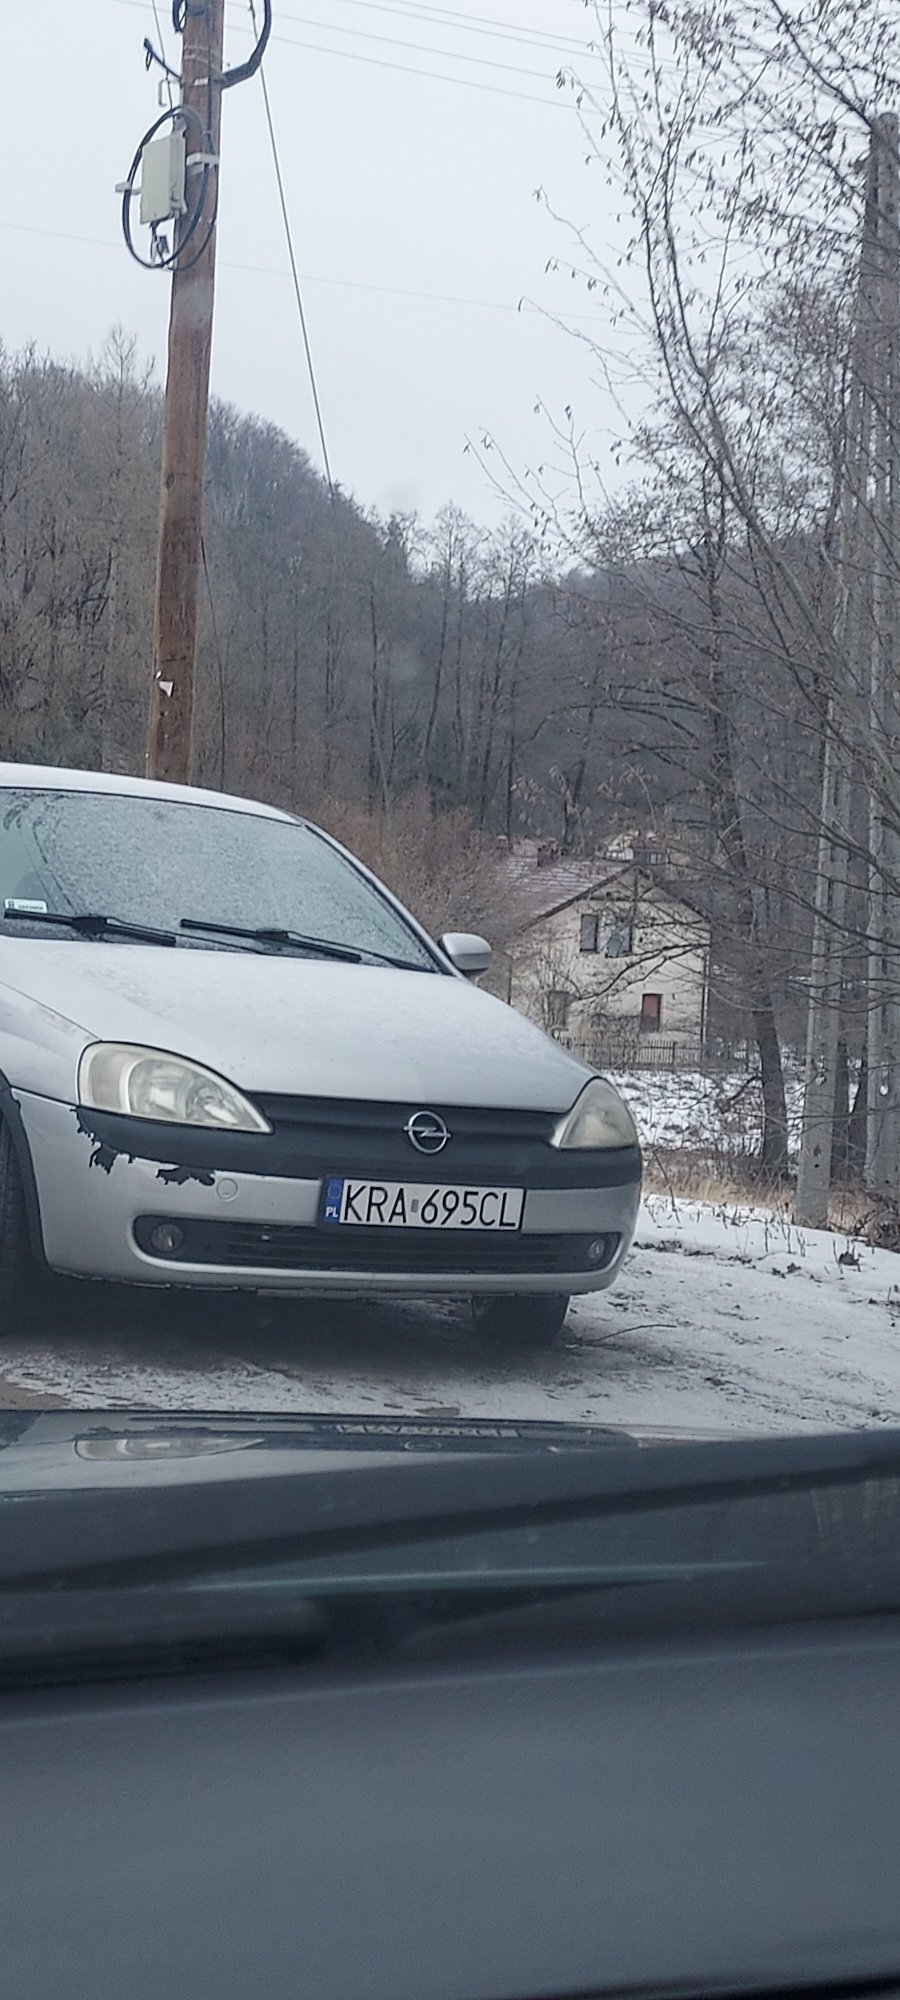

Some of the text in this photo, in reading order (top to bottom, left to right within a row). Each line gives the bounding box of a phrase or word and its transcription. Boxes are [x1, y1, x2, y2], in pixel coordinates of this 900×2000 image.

[325, 1206, 338, 1218] PL
[344, 1185, 516, 1227] KRA 695CL
